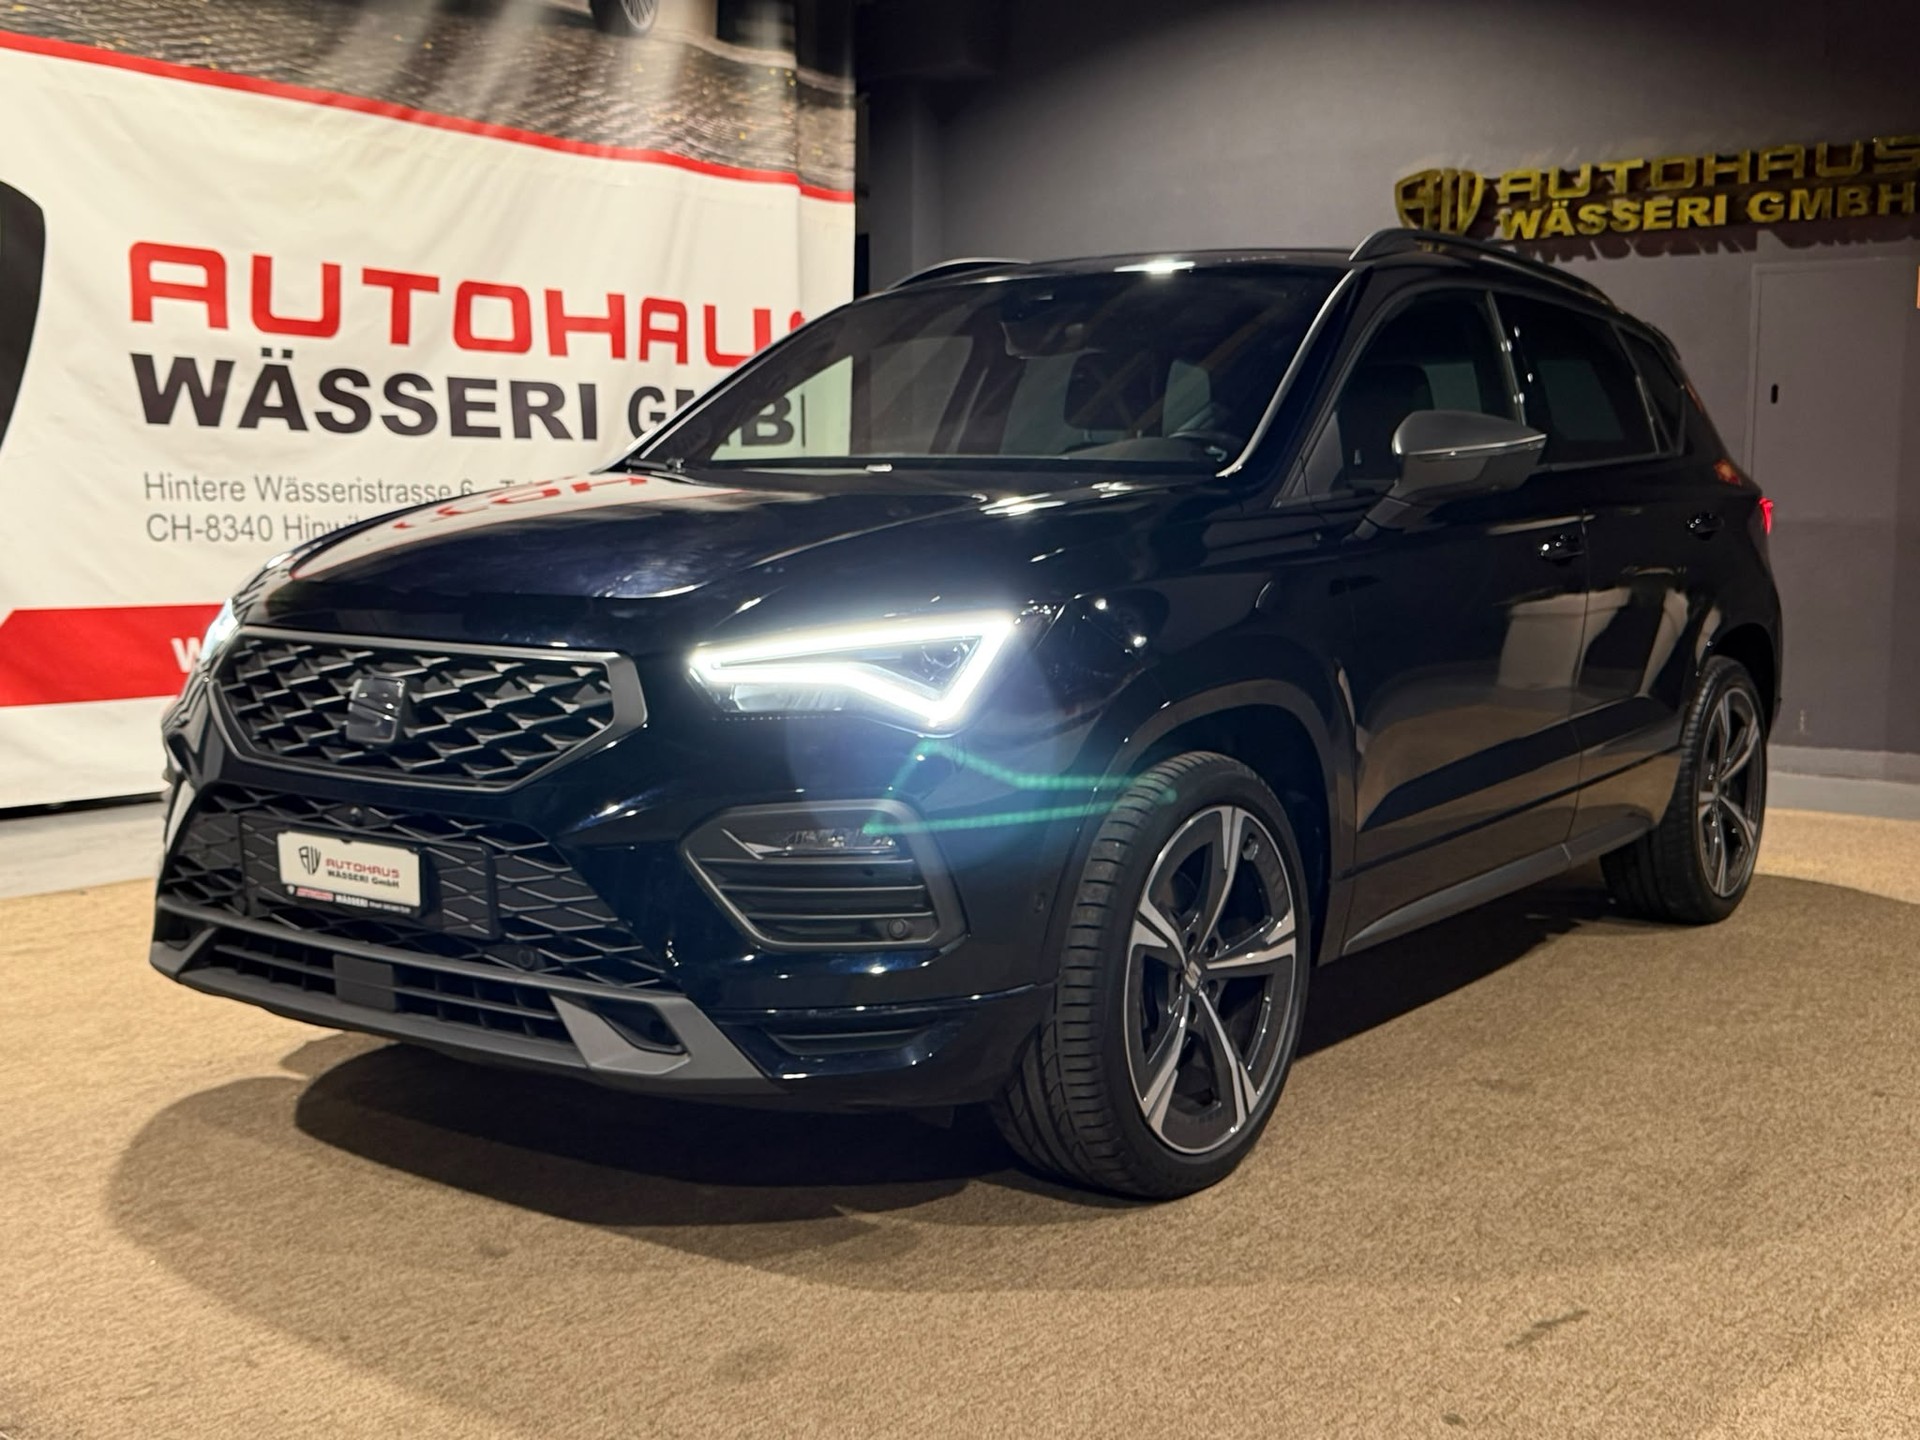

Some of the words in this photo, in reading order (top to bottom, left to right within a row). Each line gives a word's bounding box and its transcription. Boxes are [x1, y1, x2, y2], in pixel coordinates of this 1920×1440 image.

[1498, 134, 1920, 203] AUTOHAUS
[1498, 195, 1728, 240] WÄSSERI
[1746, 181, 1916, 223] GMBH
[129, 241, 806, 368] AUTOHAU
[130, 347, 598, 441] WÄSSERI
[144, 472, 246, 502] Hintere
[253, 474, 452, 503] Wässeristrasse
[146, 513, 273, 542] CH-8340
[326, 858, 400, 878] AUTOHAUS
